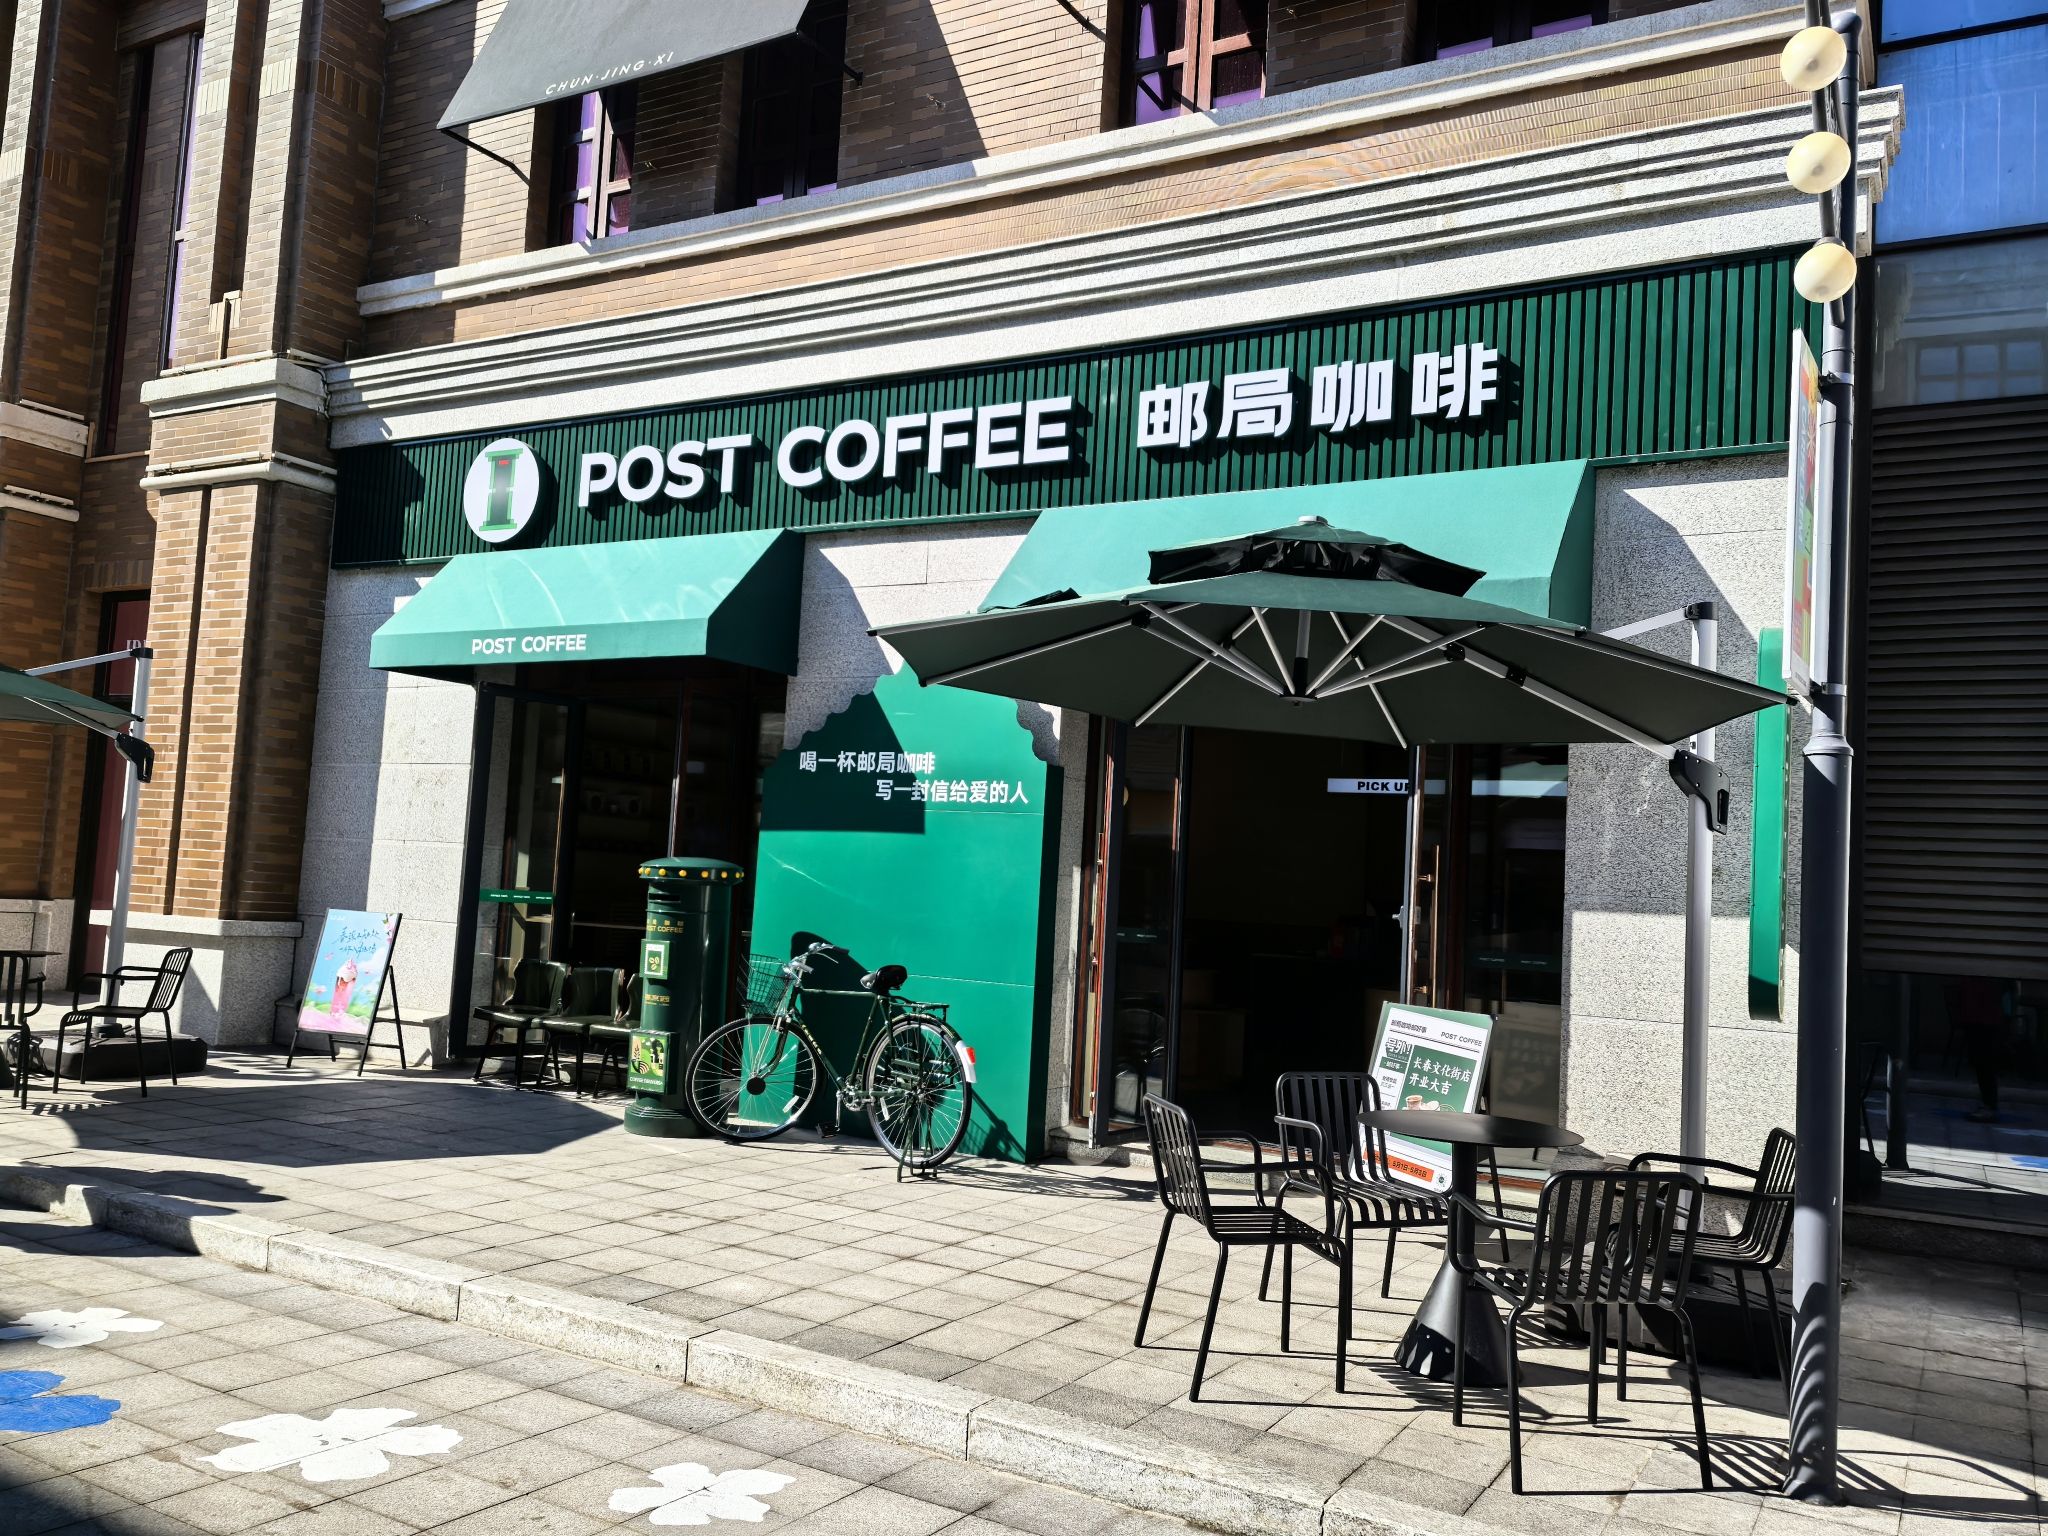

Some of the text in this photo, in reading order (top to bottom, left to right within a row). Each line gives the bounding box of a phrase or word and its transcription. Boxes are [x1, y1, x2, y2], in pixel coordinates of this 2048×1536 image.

[1136, 342, 1498, 448] 邮局咖啡
[578, 395, 1073, 507] POST COFFEE
[471, 633, 588, 655] POST COFFEE
[799, 751, 936, 774] 喝一杯邮局咖啡
[875, 779, 1030, 805] 写一封信给爱的人
[1357, 781, 1390, 792] PICK
[1440, 1031, 1483, 1047] POST COFFEE
[1413, 1057, 1472, 1083] 长春文化街店
[1408, 1073, 1453, 1096] 开业大吉
